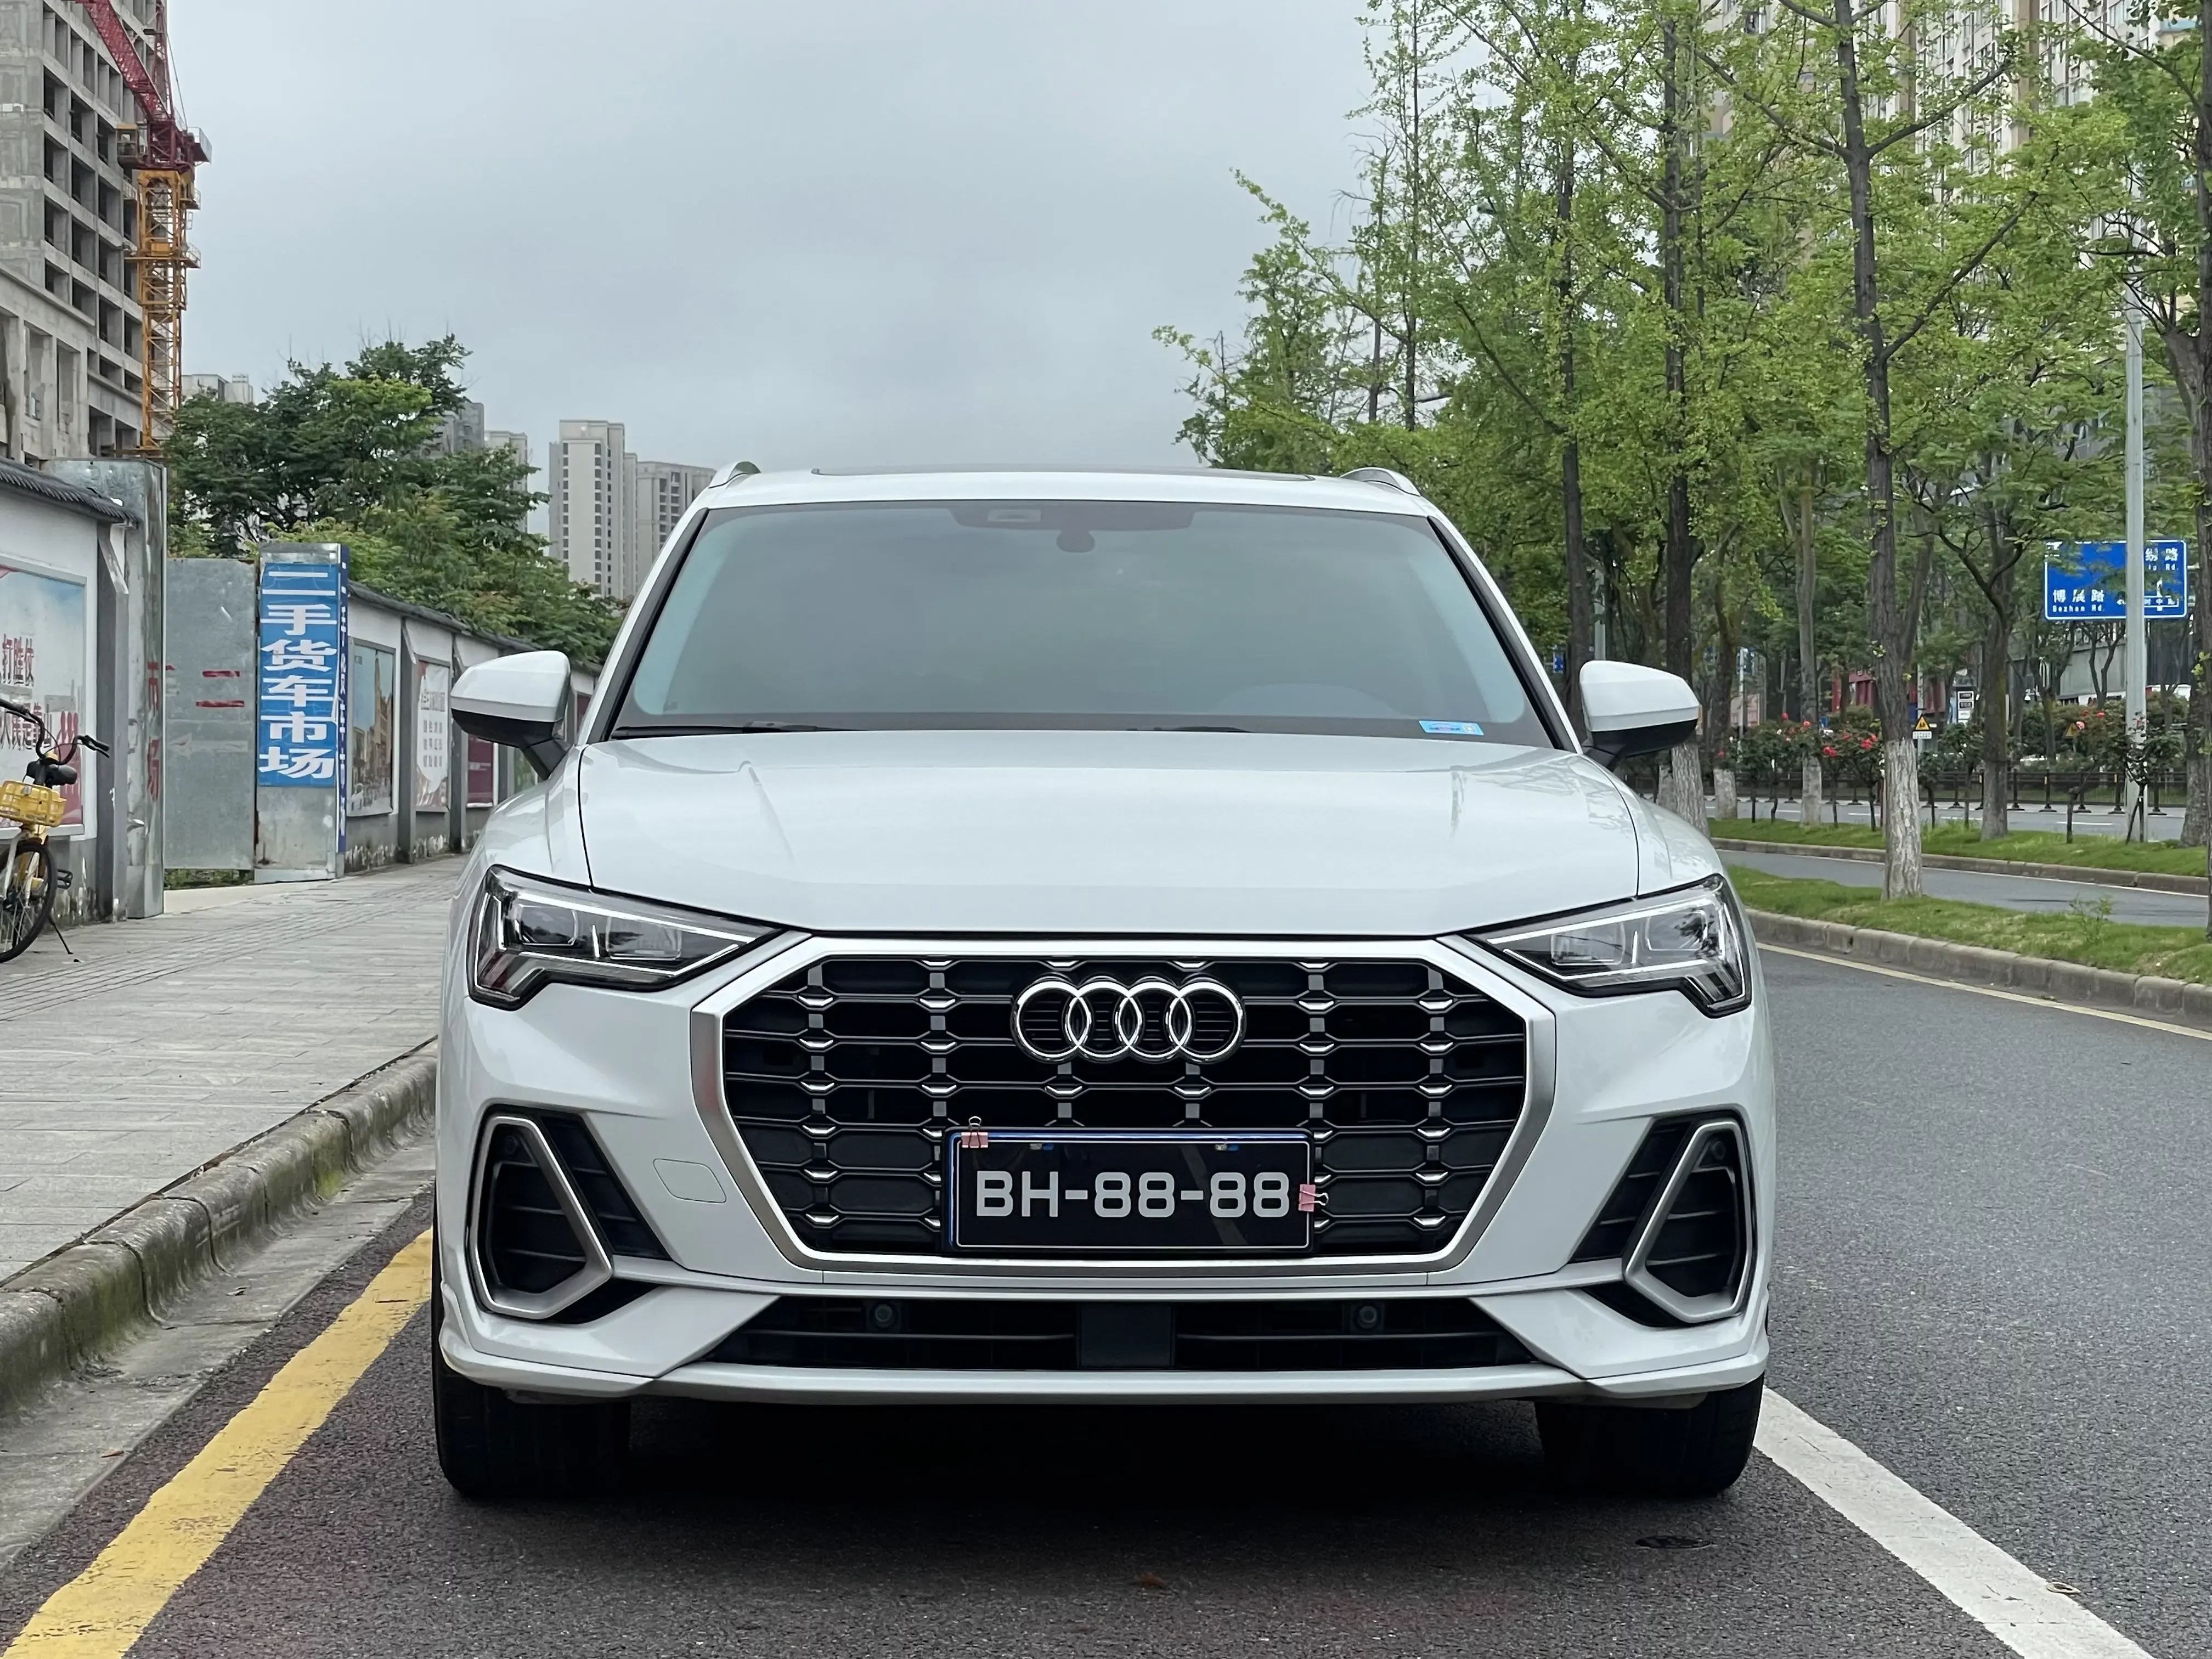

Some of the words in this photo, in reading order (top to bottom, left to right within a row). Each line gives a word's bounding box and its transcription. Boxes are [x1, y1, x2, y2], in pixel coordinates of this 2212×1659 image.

[2053, 589, 2104, 603] 博展路
[258, 571, 336, 779] 二手货车市场
[977, 1171, 1289, 1217] BH-88-88
